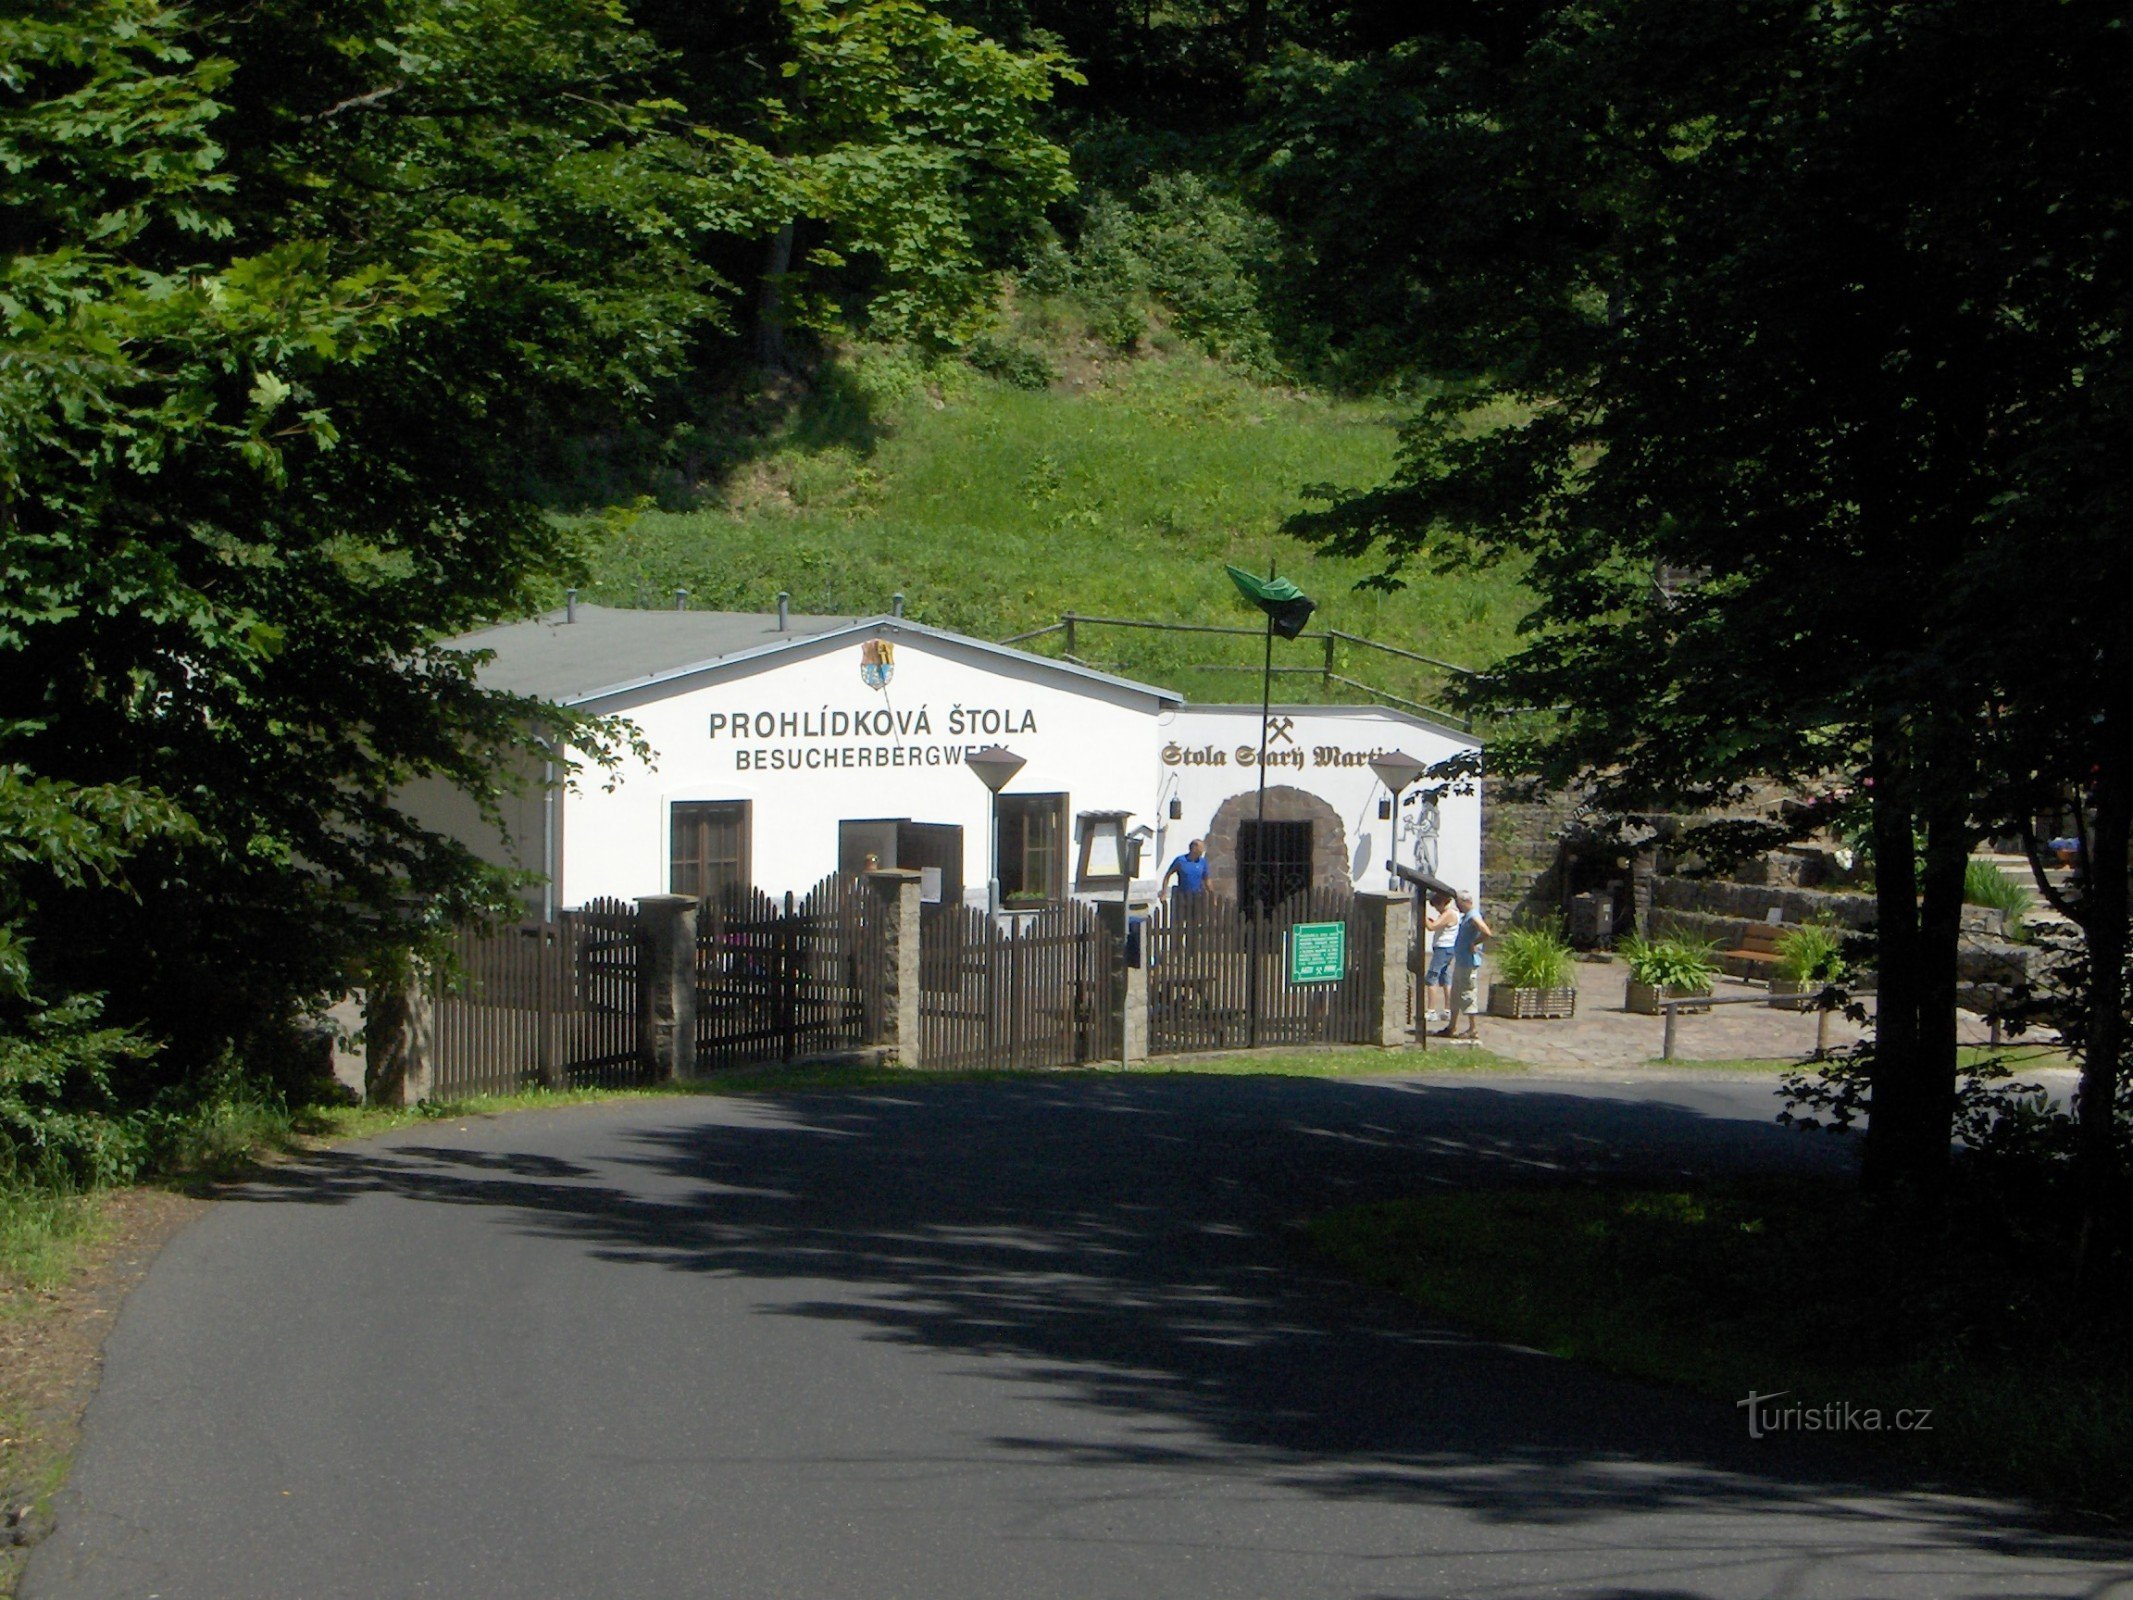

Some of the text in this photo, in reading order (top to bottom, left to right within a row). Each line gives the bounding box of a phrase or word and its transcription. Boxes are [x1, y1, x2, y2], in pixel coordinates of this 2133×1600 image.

[709, 703, 1038, 739] PROHLÍDKOVÁ ŠTOLA
[735, 744, 1009, 771] BESUCHERBERGWE
[1161, 740, 1228, 767] Štola
[1312, 745, 1392, 767] Marti
